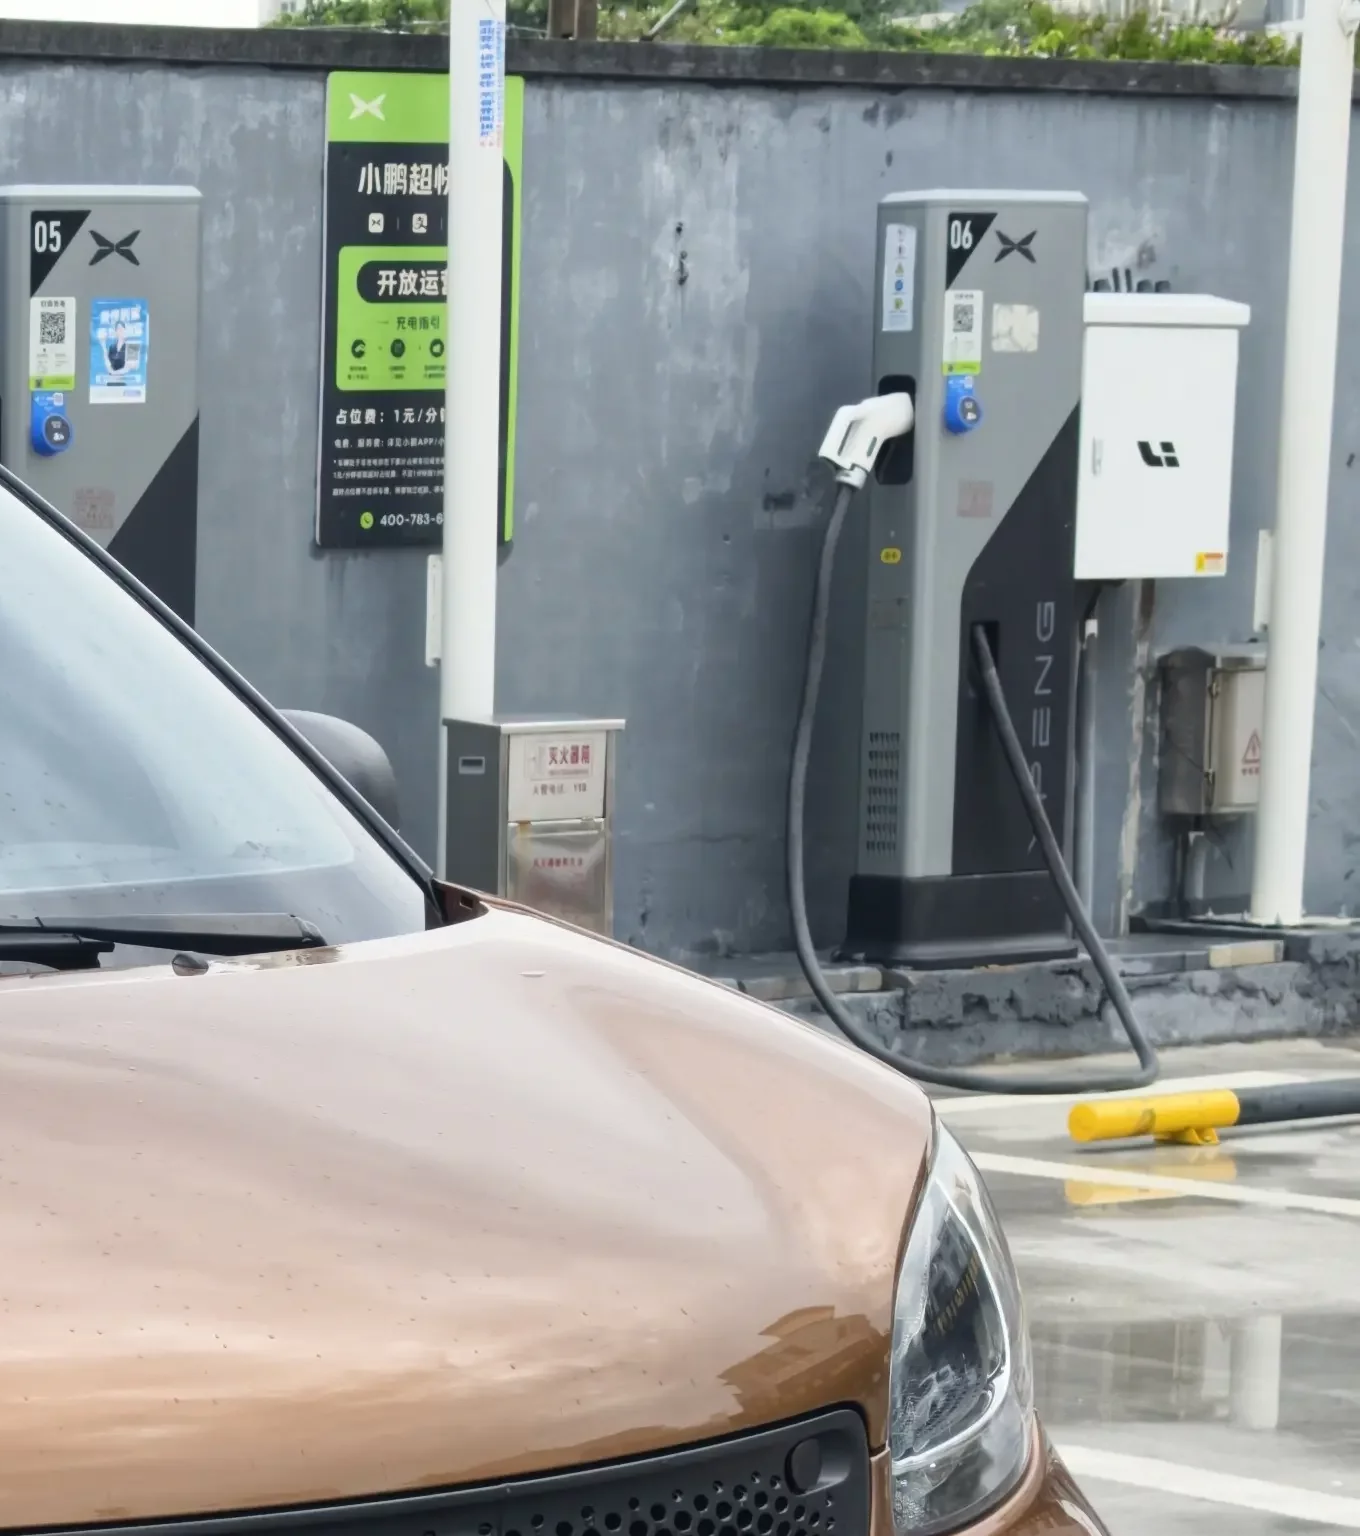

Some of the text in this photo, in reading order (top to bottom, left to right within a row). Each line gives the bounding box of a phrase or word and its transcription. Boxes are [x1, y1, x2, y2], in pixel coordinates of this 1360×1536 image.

[34, 220, 62, 254] 05
[951, 220, 973, 249] 06
[380, 513, 445, 527] 400-783-6
[549, 745, 590, 765] 灭火器箱
